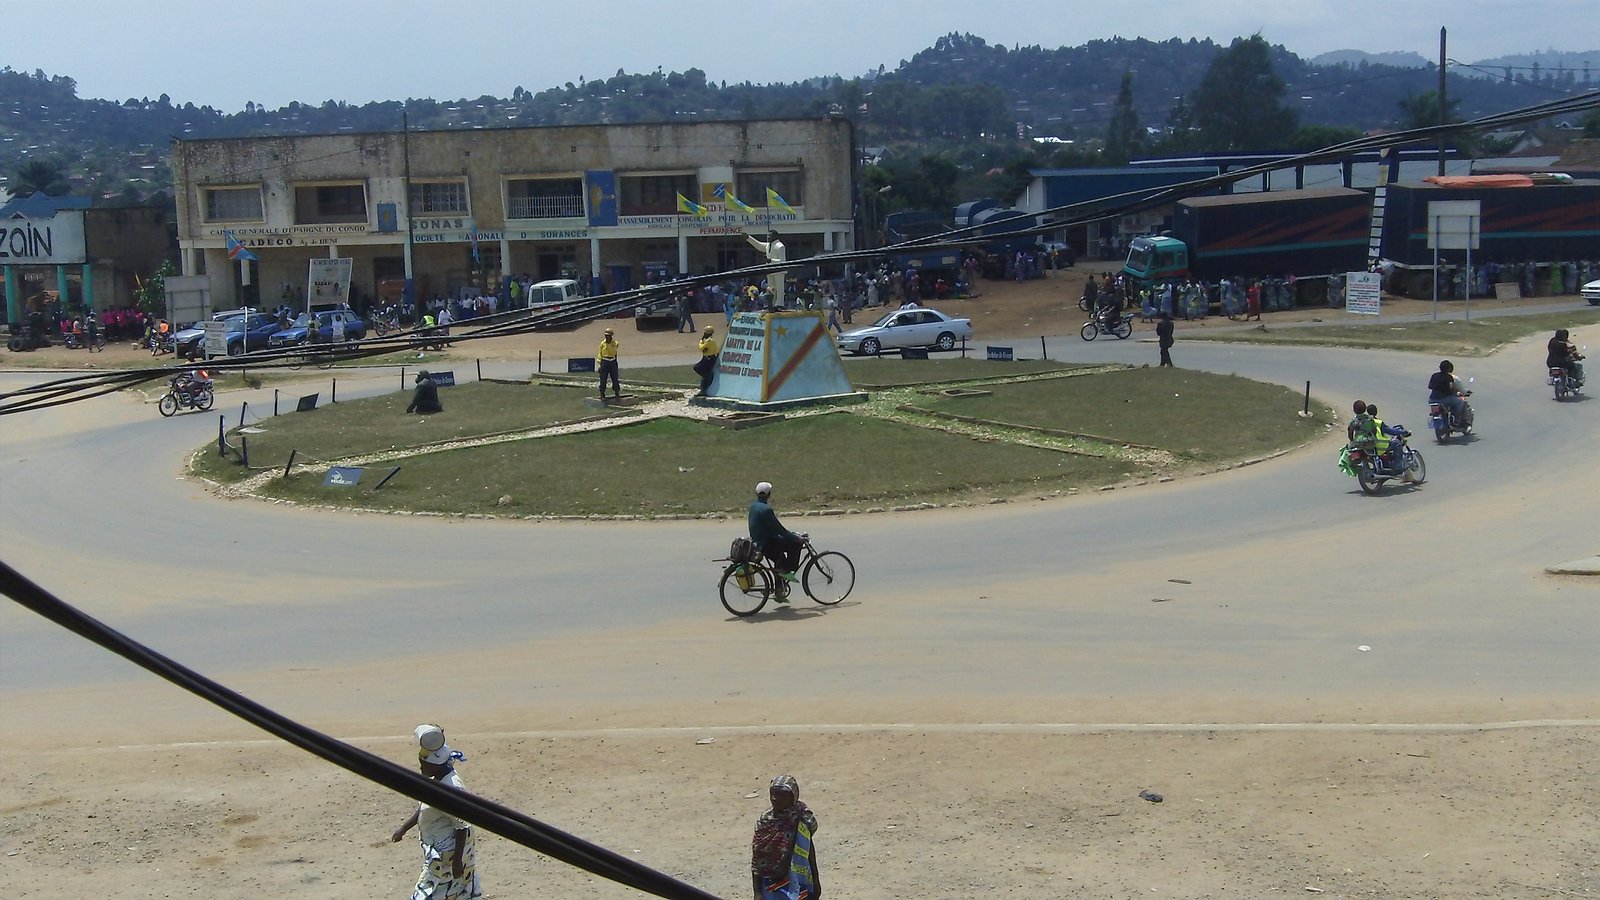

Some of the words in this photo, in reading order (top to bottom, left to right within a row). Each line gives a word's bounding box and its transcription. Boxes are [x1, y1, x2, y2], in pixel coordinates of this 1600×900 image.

[755, 213, 797, 221] DEMOCRATIE
[410, 219, 463, 229] SONAS
[413, 234, 446, 242] OCIETE
